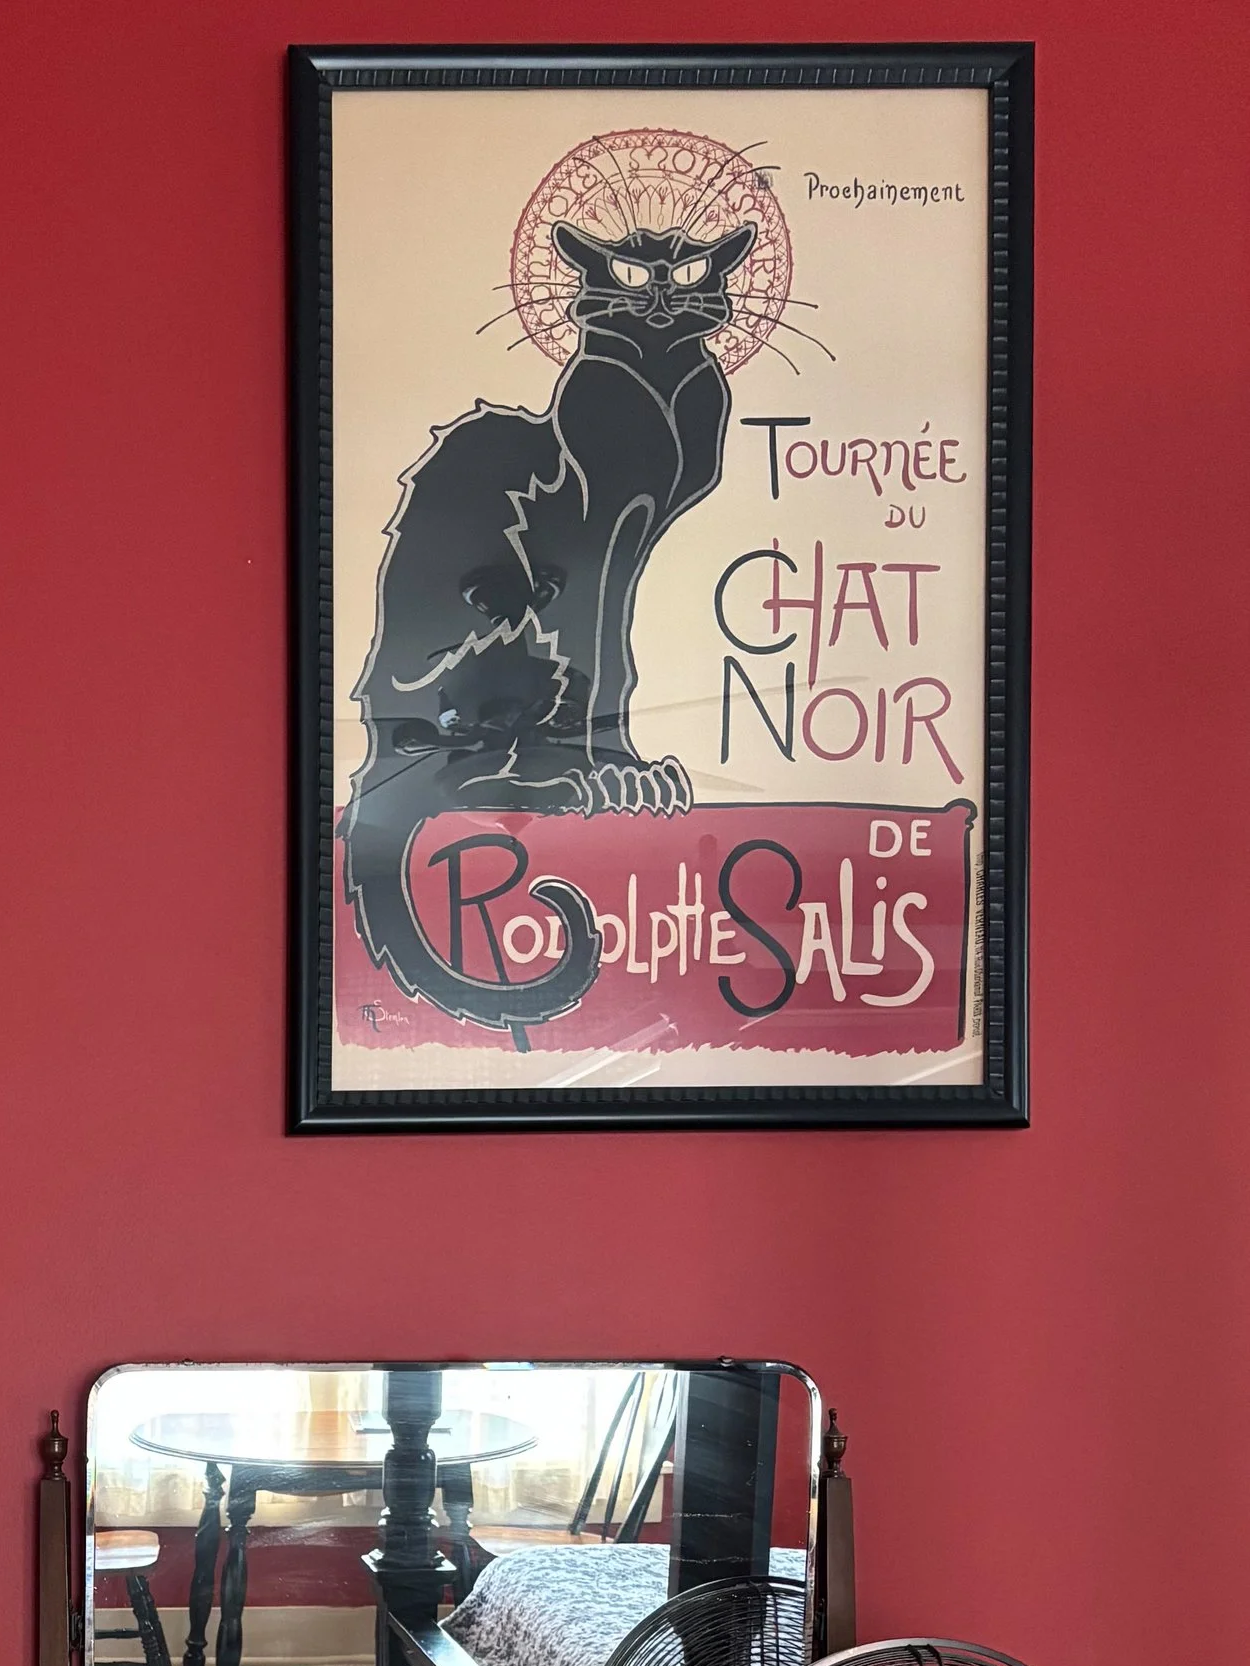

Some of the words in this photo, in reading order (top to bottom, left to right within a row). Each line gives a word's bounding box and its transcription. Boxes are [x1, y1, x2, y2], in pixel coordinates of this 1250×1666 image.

[803, 172, 966, 208] Prochainement
[883, 503, 927, 530] DU
[713, 538, 941, 690] CHAT
[720, 654, 965, 785] NOIR
[868, 819, 932, 858] DE
